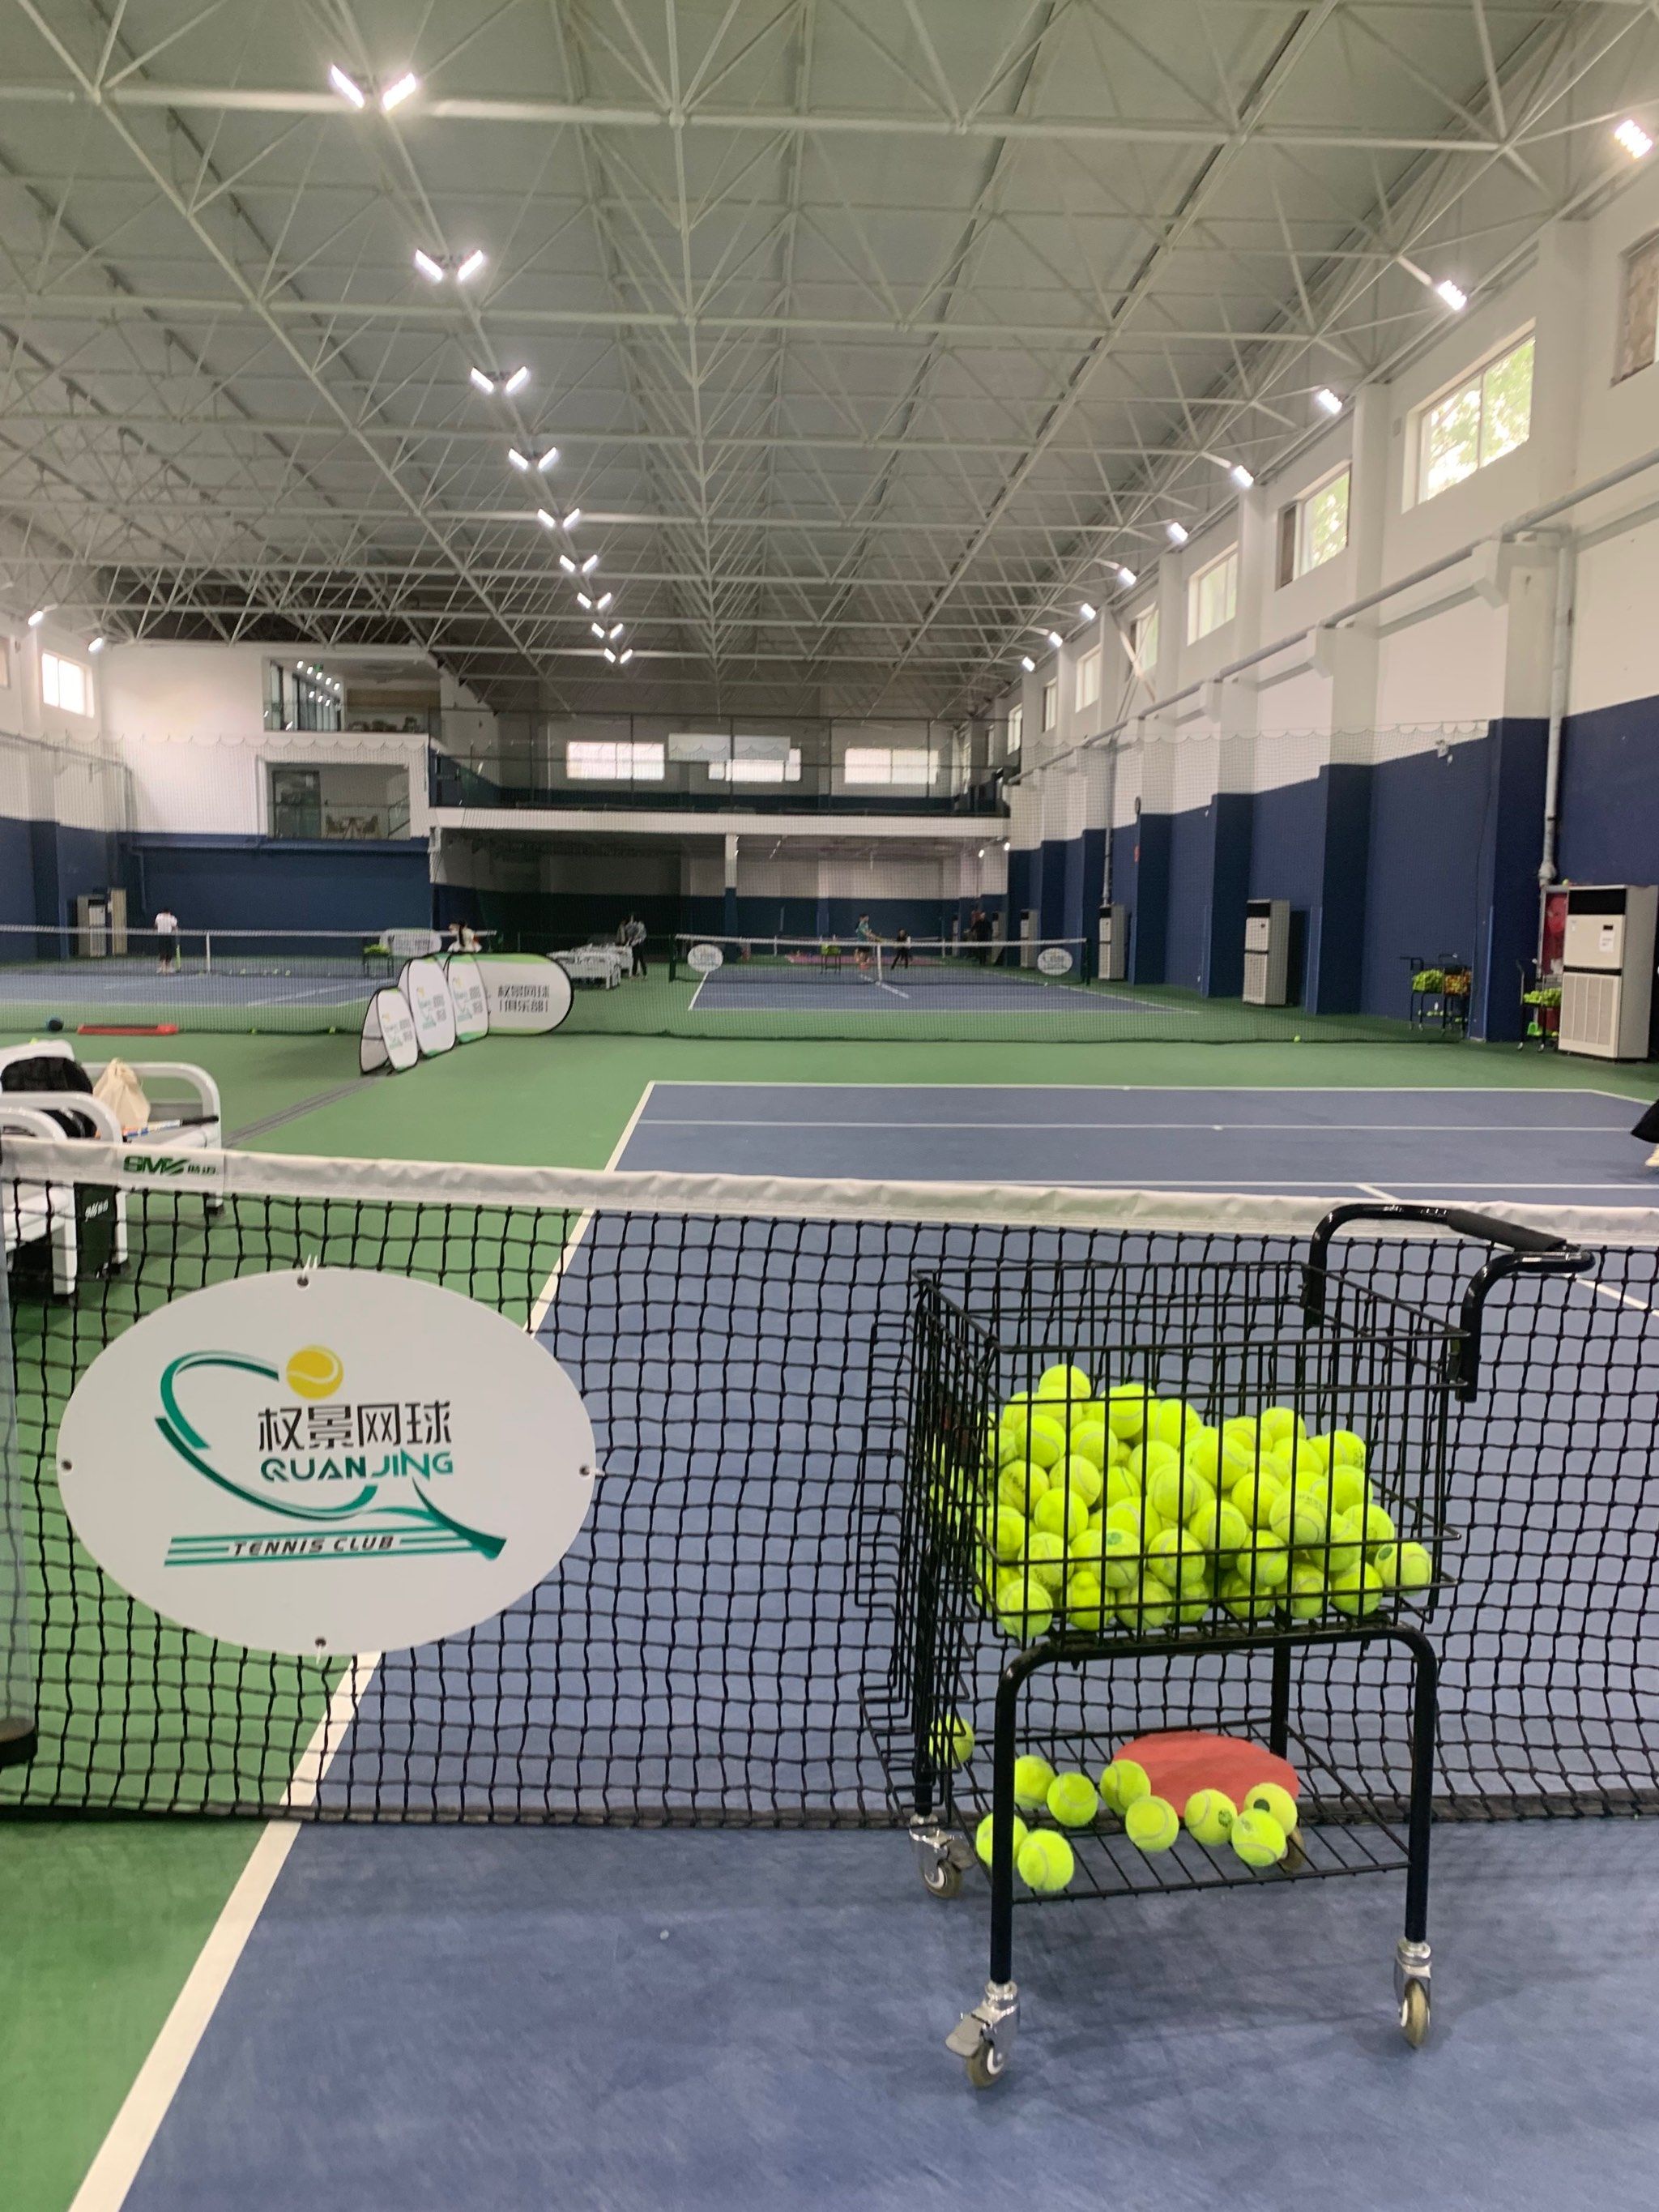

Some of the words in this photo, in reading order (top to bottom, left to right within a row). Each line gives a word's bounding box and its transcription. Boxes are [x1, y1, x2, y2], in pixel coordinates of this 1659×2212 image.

[258, 1400, 452, 1452] 权景网球
[260, 1448, 454, 1483] QUANJING
[234, 1537, 325, 1557] TENNIS
[333, 1535, 394, 1552] CLUB
